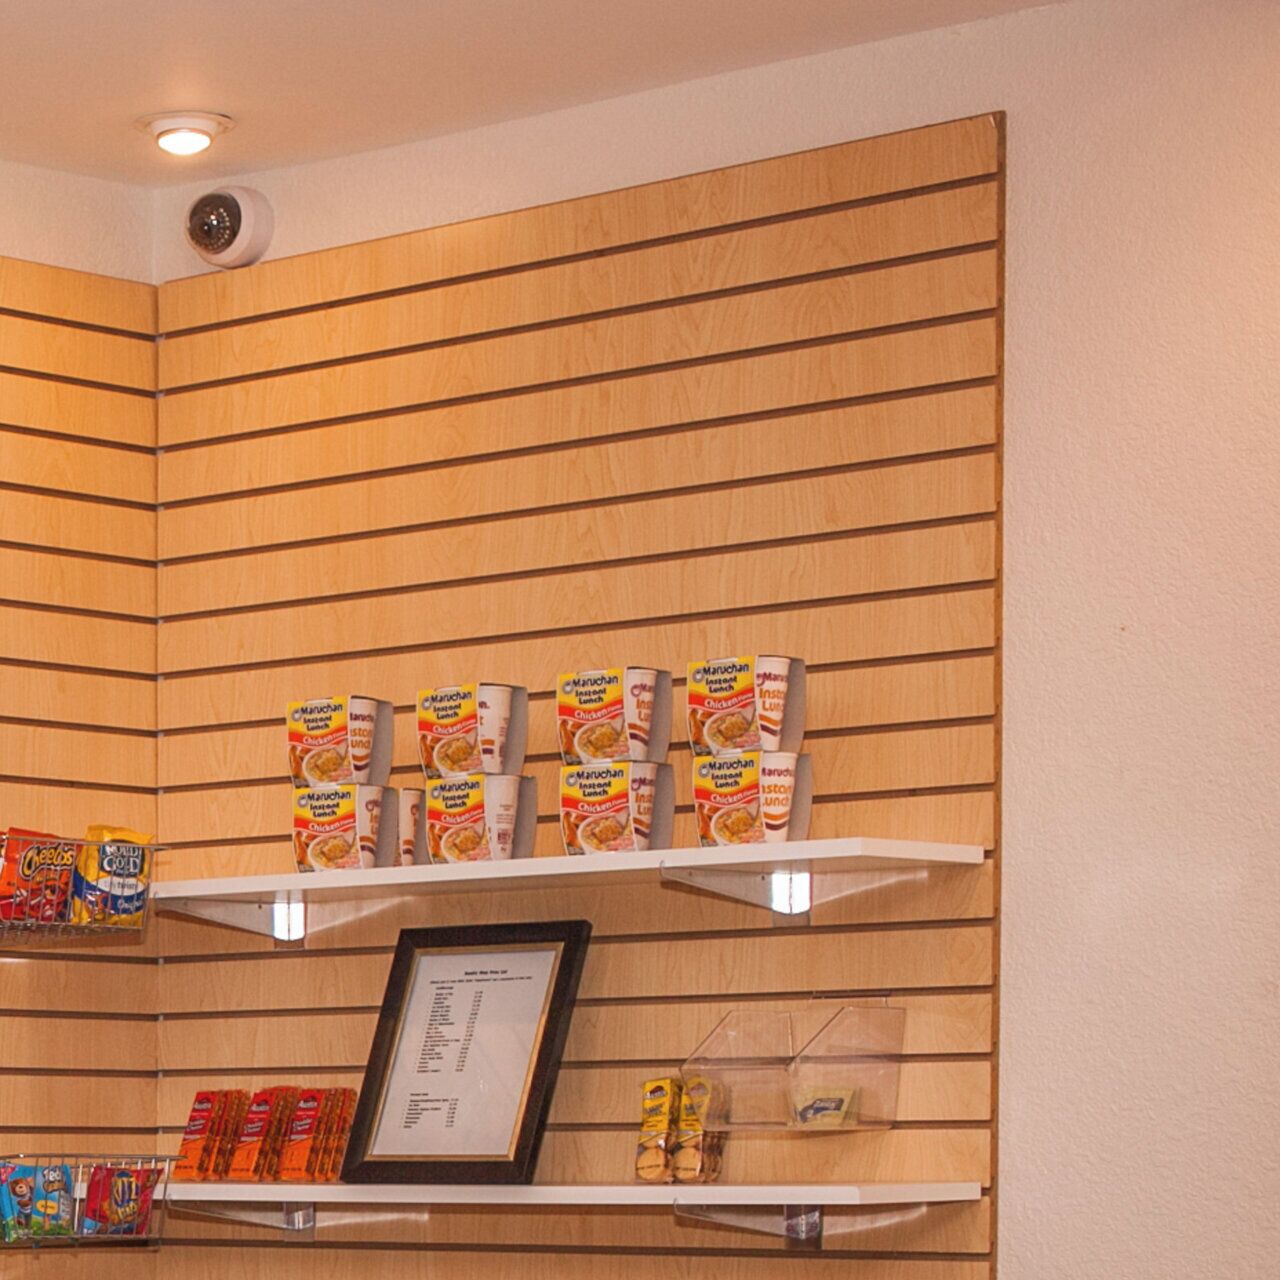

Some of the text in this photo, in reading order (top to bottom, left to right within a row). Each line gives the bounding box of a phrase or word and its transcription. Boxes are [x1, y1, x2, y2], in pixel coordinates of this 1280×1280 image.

[703, 664, 749, 675] Maruchan
[572, 676, 618, 687] Maruchan
[706, 676, 737, 685] Instant
[575, 688, 606, 697] Instant
[709, 685, 734, 693] Lunch
[431, 691, 472, 704] Maruchan
[579, 696, 603, 704] Lunch
[705, 696, 738, 707] Chicken
[300, 704, 343, 715] Maruchan
[433, 703, 462, 712] Instant
[437, 711, 459, 719] Lunch
[575, 708, 607, 719] Chicken
[303, 715, 332, 724] Instant
[307, 722, 330, 731] Lunch
[433, 723, 461, 734] Chicken
[303, 734, 332, 745] Chicken
[708, 759, 754, 771] Maruchan
[576, 769, 624, 780] Maruchan
[711, 771, 743, 780] Instant
[440, 780, 480, 793] Maruchan
[579, 781, 612, 790] Instant
[715, 779, 740, 788] Lunch
[307, 790, 351, 801] Maruchan
[442, 793, 470, 802] Instant
[583, 789, 608, 798] Lunch
[711, 792, 744, 803] Chicken
[310, 802, 340, 810] Instant
[445, 800, 467, 809] Lunch
[578, 801, 612, 812] Chicken
[313, 810, 337, 818] Lunch
[441, 813, 469, 823] Chicken
[309, 822, 339, 832] Chicken
[21, 844, 73, 879] Cheetos
